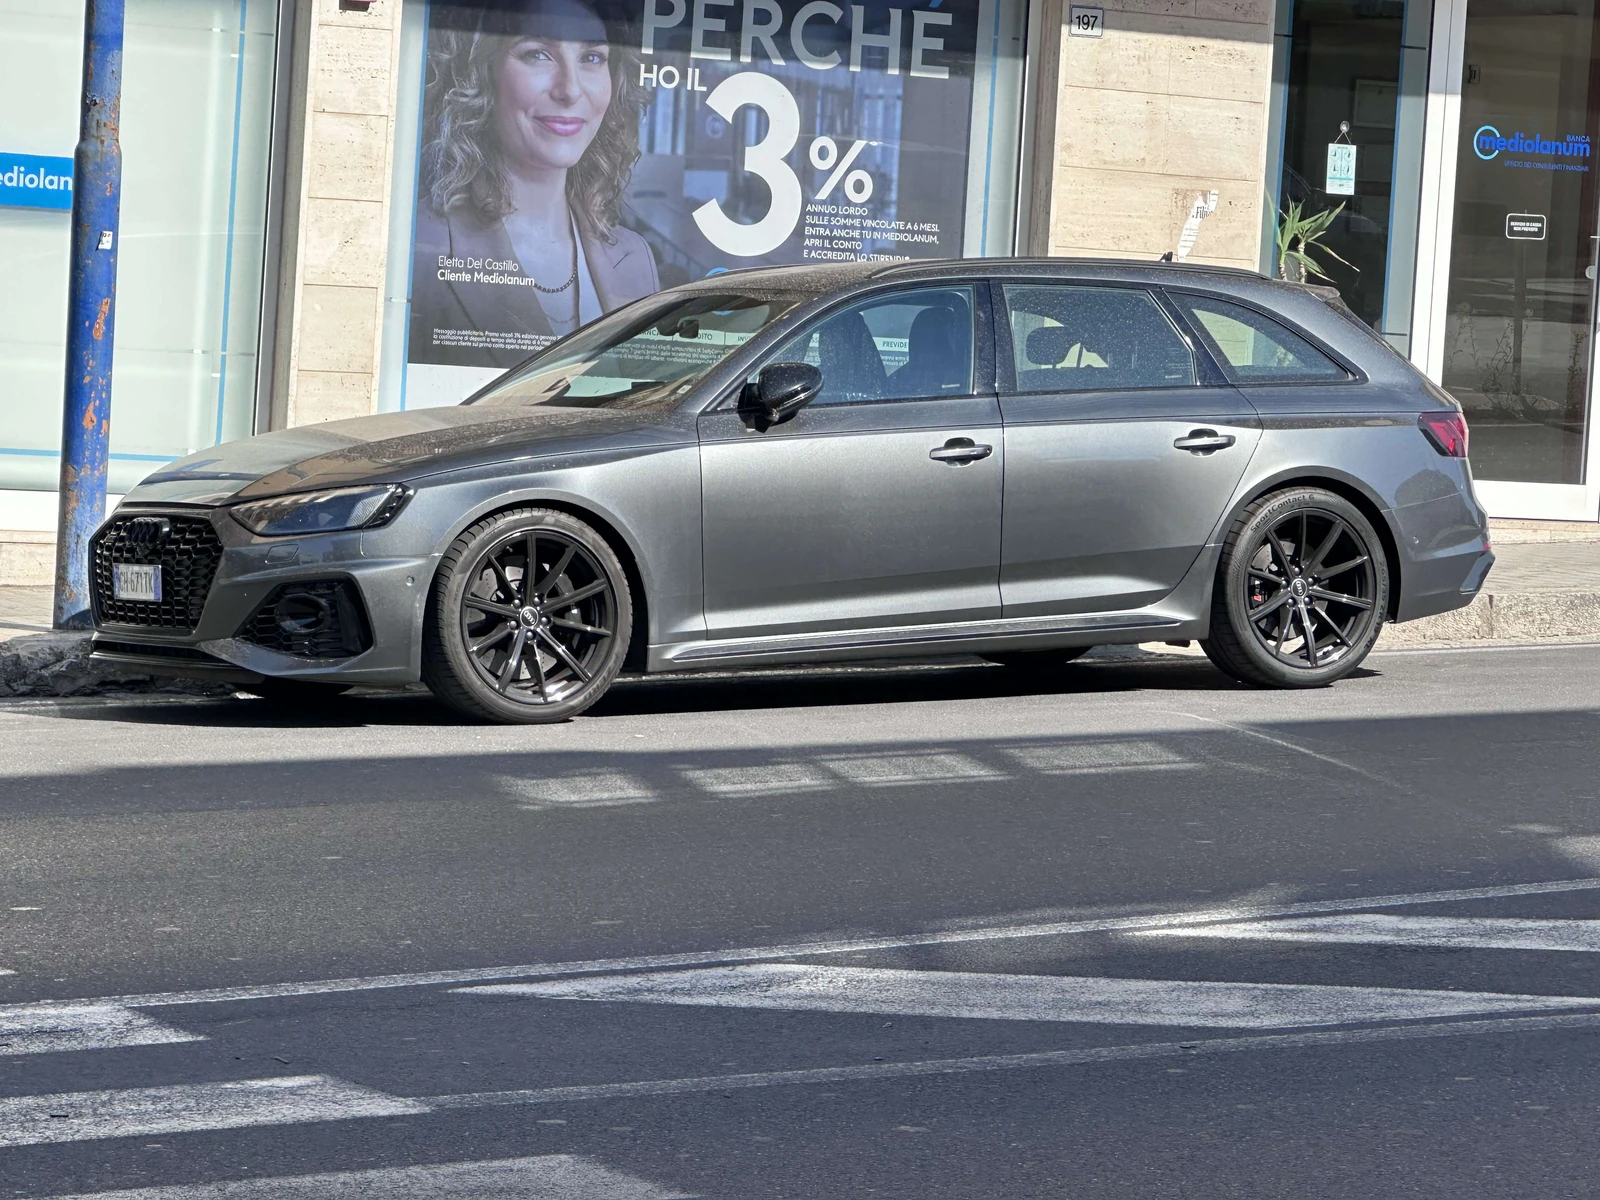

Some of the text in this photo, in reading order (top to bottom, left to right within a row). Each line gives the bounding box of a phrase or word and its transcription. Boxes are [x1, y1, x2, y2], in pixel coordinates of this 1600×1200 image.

[1075, 14, 1098, 31] 197
[642, 0, 952, 78] PERCHÉ
[639, 64, 679, 89] HO
[687, 67, 707, 91] IL
[1479, 131, 1591, 157] mediolanum
[1566, 135, 1591, 143] BANCA
[0, 165, 73, 191] diolan
[806, 204, 868, 215] ANNUO LORDO
[806, 215, 940, 232] SULLE SOMME VINCOLATE A 6 MESI.
[804, 238, 822, 247] APRI
[832, 240, 862, 250] CONTO
[805, 227, 830, 236] ENTRA
[832, 229, 860, 238] ANCHE
[862, 230, 872, 239] TU
[882, 232, 939, 244] MEDIOLANUM,
[438, 255, 519, 271] Eletta Del Castillo
[804, 250, 809, 258] E
[810, 250, 855, 261] ACCREDITA
[857, 253, 867, 262] LO
[437, 269, 535, 286] Cliente Mediolanum
[1251, 494, 1306, 533] SportContact
